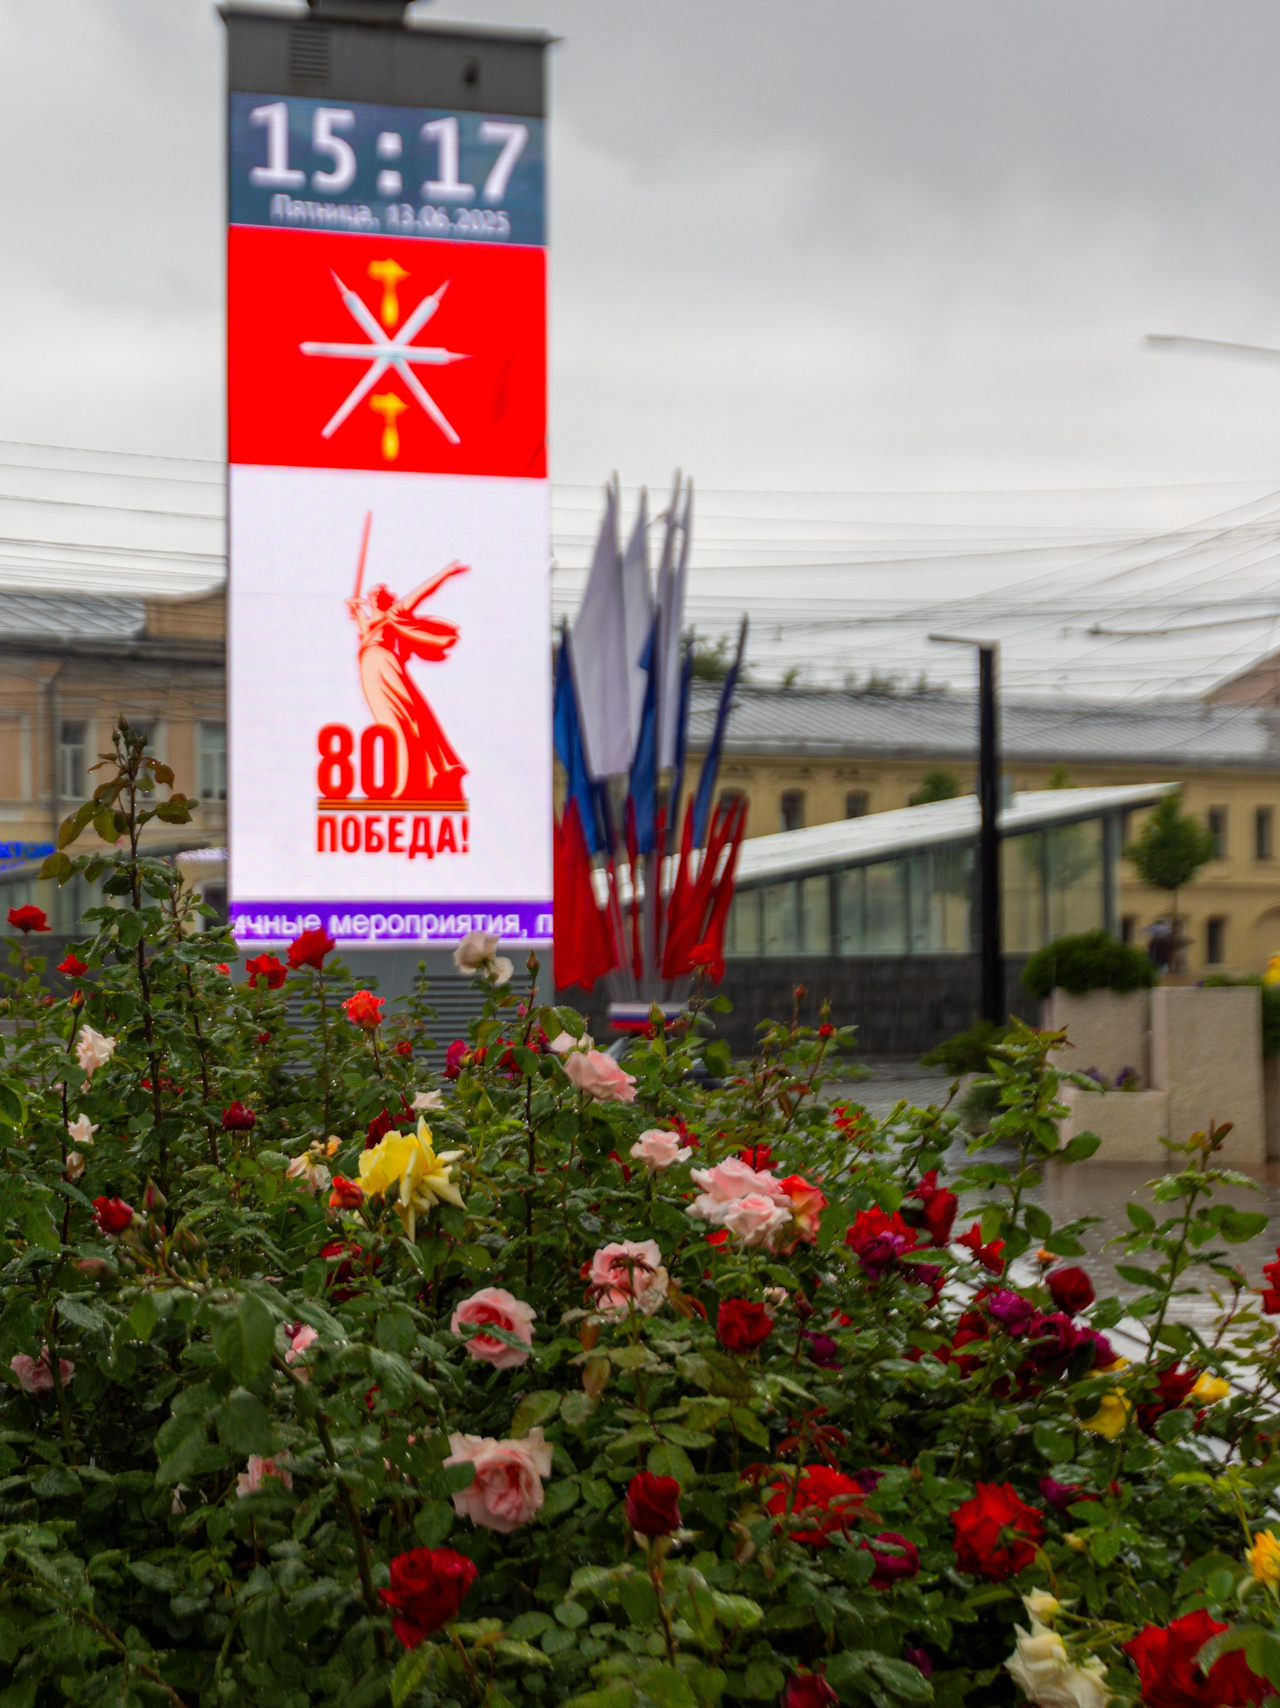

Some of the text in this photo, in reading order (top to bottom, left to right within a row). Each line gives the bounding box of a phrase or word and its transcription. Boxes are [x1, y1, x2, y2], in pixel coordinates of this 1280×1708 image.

[249, 102, 529, 204] 15:17
[385, 202, 511, 242] 13.06.2025
[317, 721, 398, 800] 80
[317, 814, 469, 859] ПОБЕДА!
[328, 913, 528, 939] мероприятия,
